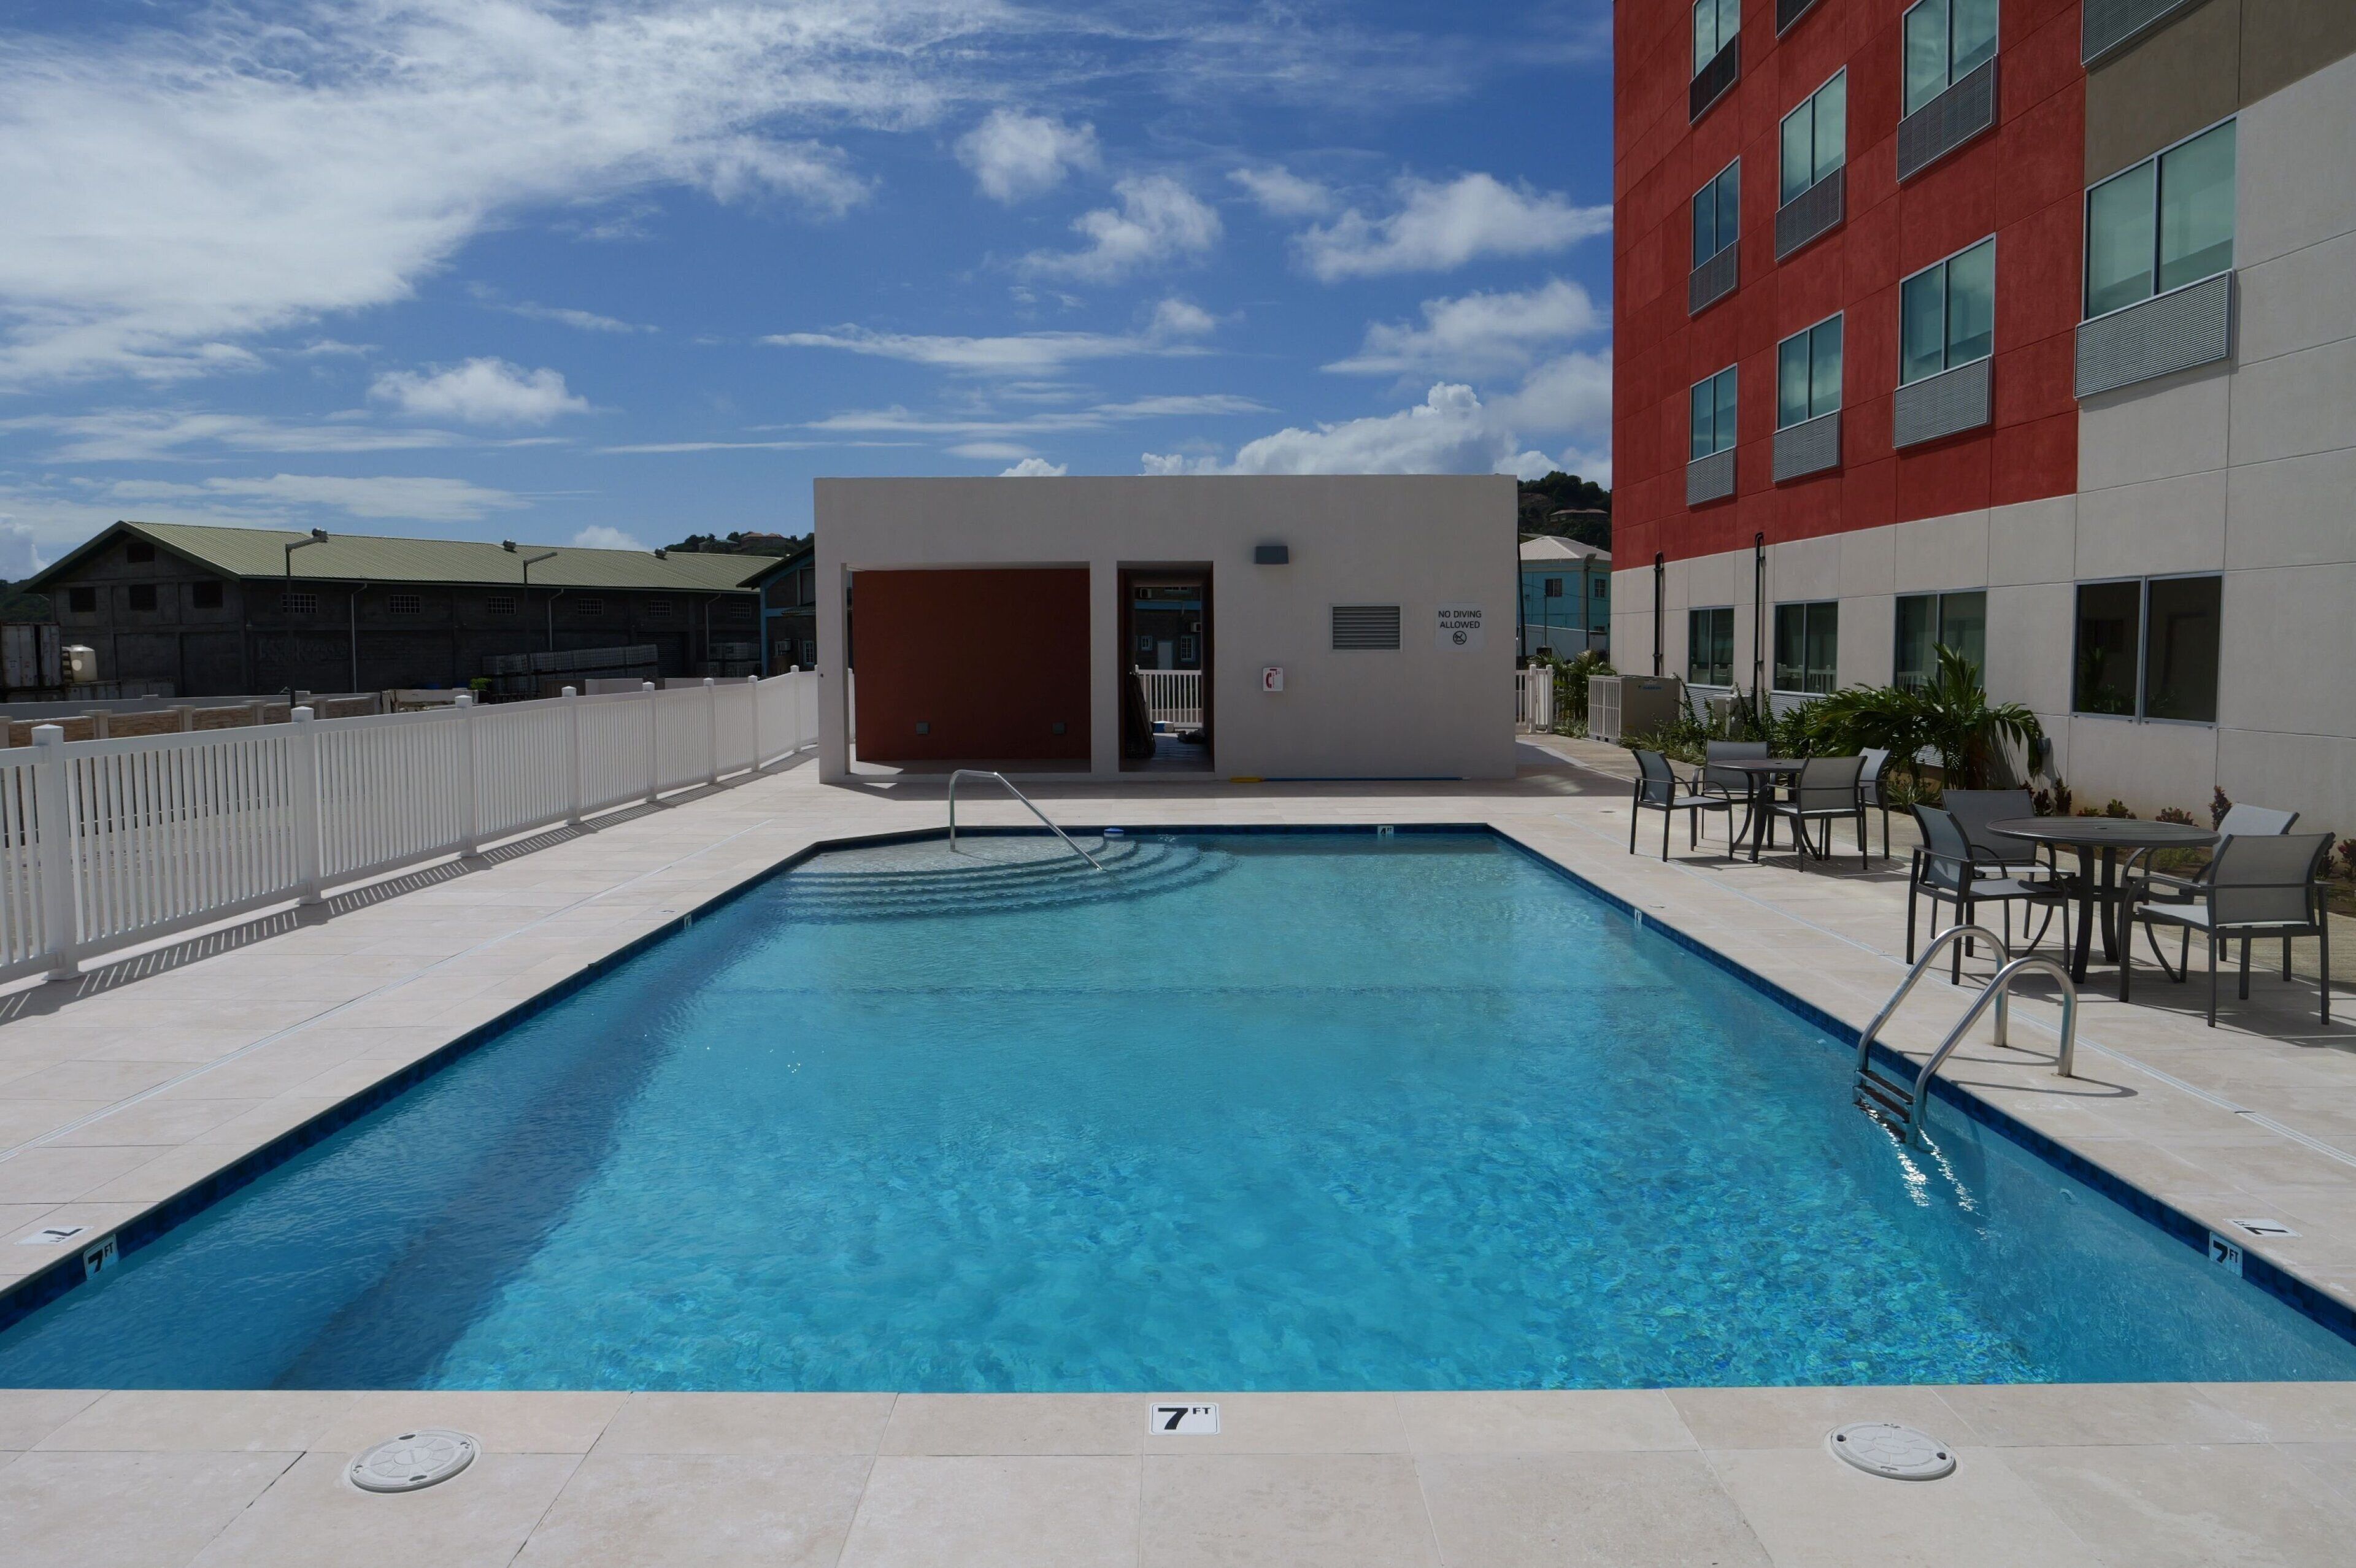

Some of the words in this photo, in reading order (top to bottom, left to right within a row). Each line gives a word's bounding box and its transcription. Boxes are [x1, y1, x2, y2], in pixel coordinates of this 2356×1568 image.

[88, 1249, 103, 1274] 7
[104, 1242, 113, 1257] FT
[2213, 1240, 2228, 1263] 7
[2229, 1249, 2239, 1262] FT
[1158, 1407, 1188, 1430] 7
